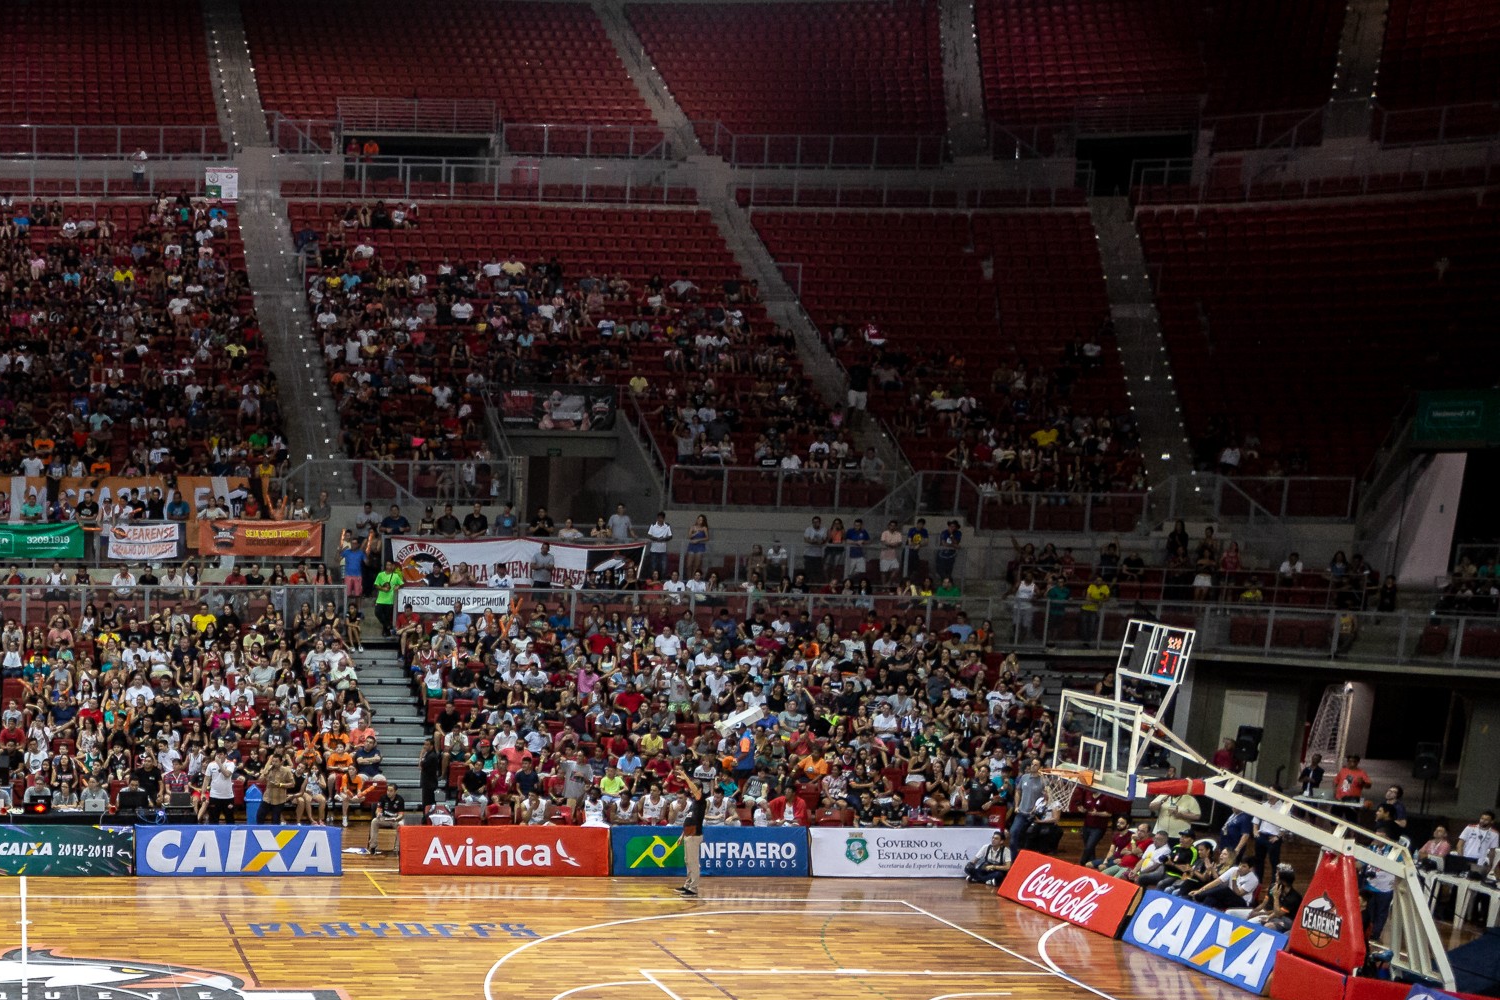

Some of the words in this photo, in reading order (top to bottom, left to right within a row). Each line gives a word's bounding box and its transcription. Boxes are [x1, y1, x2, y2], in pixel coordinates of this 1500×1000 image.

[403, 596, 429, 606] ACESSO
[473, 597, 506, 607] PREMIUM
[58, 843, 114, 857] 2018-2019
[145, 829, 335, 873] CAIXA
[700, 842, 796, 860] NFRAERO
[876, 837, 928, 848] GOVERNO
[423, 837, 551, 867] Avianca
[878, 849, 918, 861] ESTADO
[934, 848, 969, 861] CEARÁ
[1017, 863, 1114, 923] Coca-Cola
[247, 923, 540, 938] PLAYOFFS
[1301, 906, 1341, 938] CEARENSE
[1132, 897, 1275, 987] CAIXA
